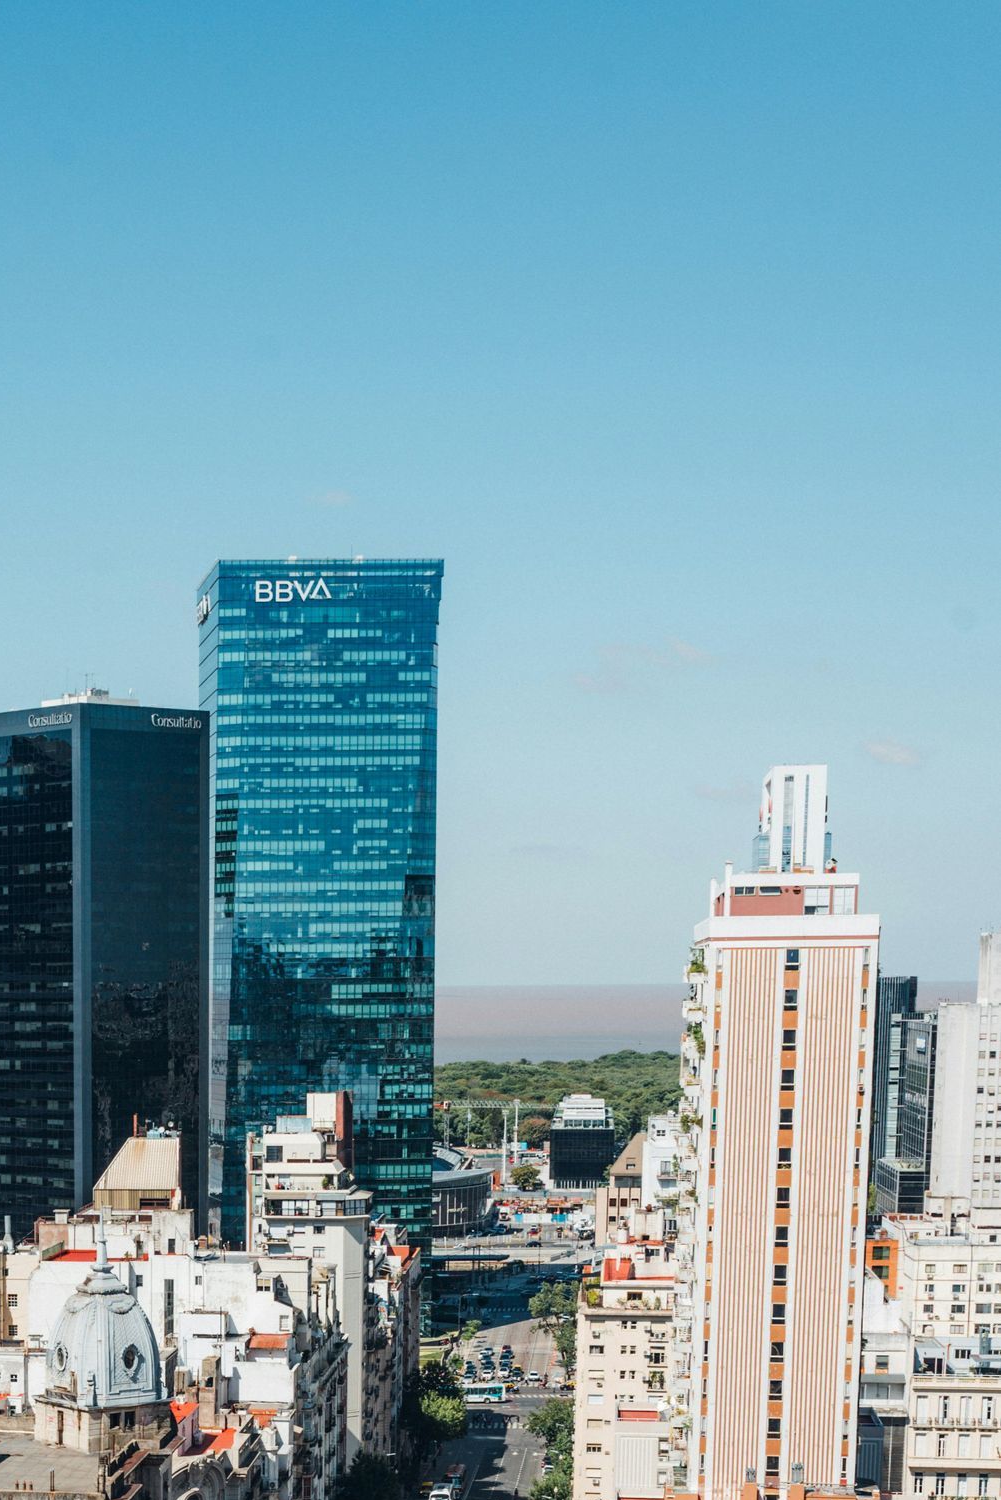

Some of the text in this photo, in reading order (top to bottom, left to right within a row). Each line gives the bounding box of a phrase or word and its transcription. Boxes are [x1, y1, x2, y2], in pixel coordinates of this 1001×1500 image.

[255, 577, 332, 602] BBVA
[28, 711, 73, 728] Consultatio
[150, 713, 202, 729] Consultatio
